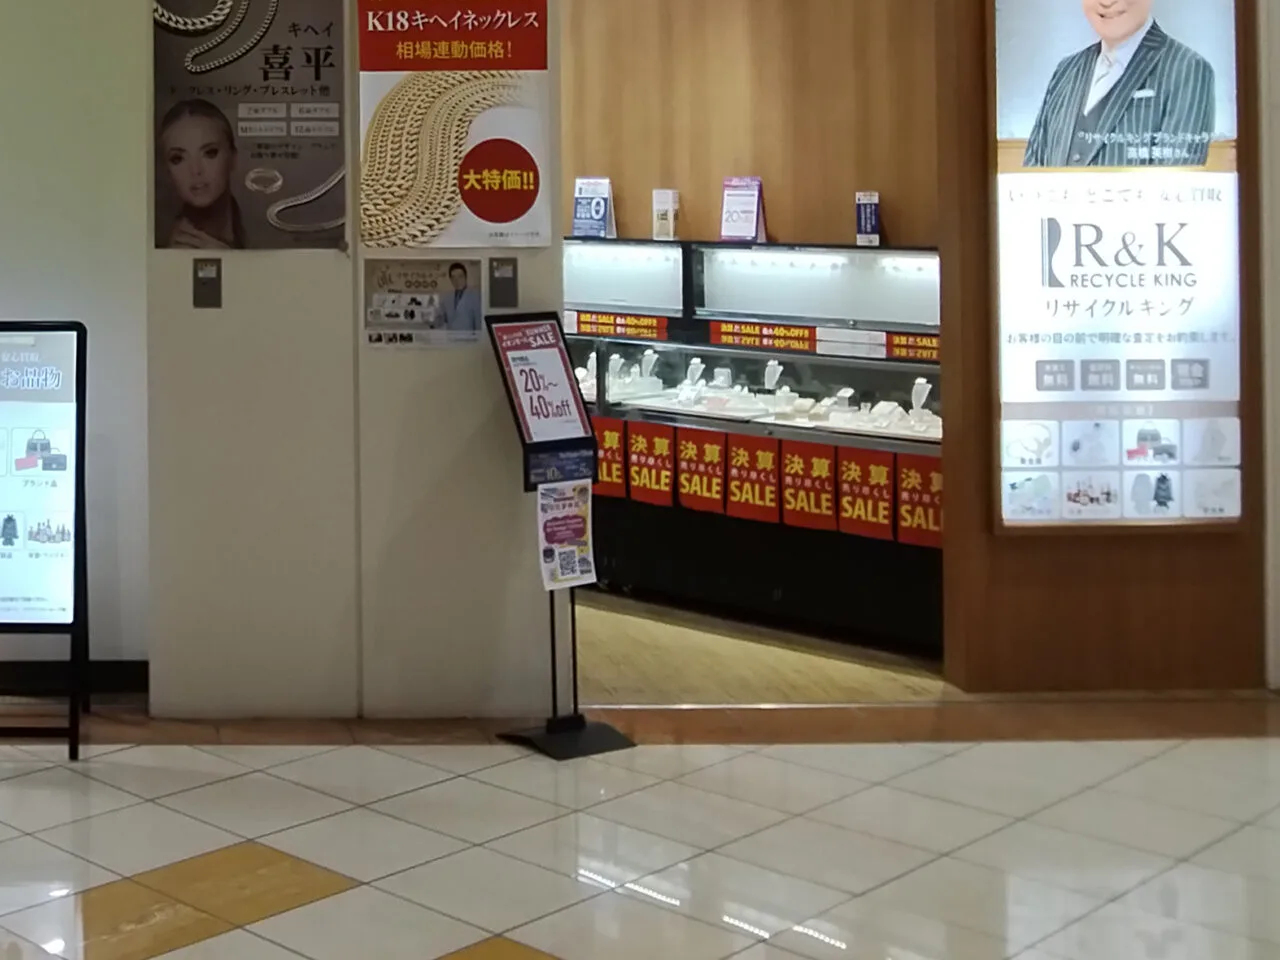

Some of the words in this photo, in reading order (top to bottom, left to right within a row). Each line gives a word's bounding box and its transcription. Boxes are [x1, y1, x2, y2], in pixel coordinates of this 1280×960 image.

[287, 21, 335, 38] キヘイ
[367, 9, 539, 32] K18キヘイネックレス
[258, 44, 336, 82] 喜平
[1072, 222, 1193, 267] R&K
[1070, 273, 1145, 288] RECYCLE
[1154, 272, 1198, 288] KING
[1045, 296, 1195, 318] リサイクルキング
[528, 332, 556, 348] SALE
[630, 433, 670, 457] 決算
[680, 440, 722, 464] 決算
[731, 447, 775, 472] 決算
[784, 453, 831, 479] 決算
[630, 466, 670, 491] SALE
[680, 473, 721, 499] SALE
[841, 460, 890, 487] 決算
[730, 480, 776, 507] SALE
[785, 488, 833, 515] SALE
[841, 496, 890, 524] SALE
[901, 504, 942, 532] SAL
